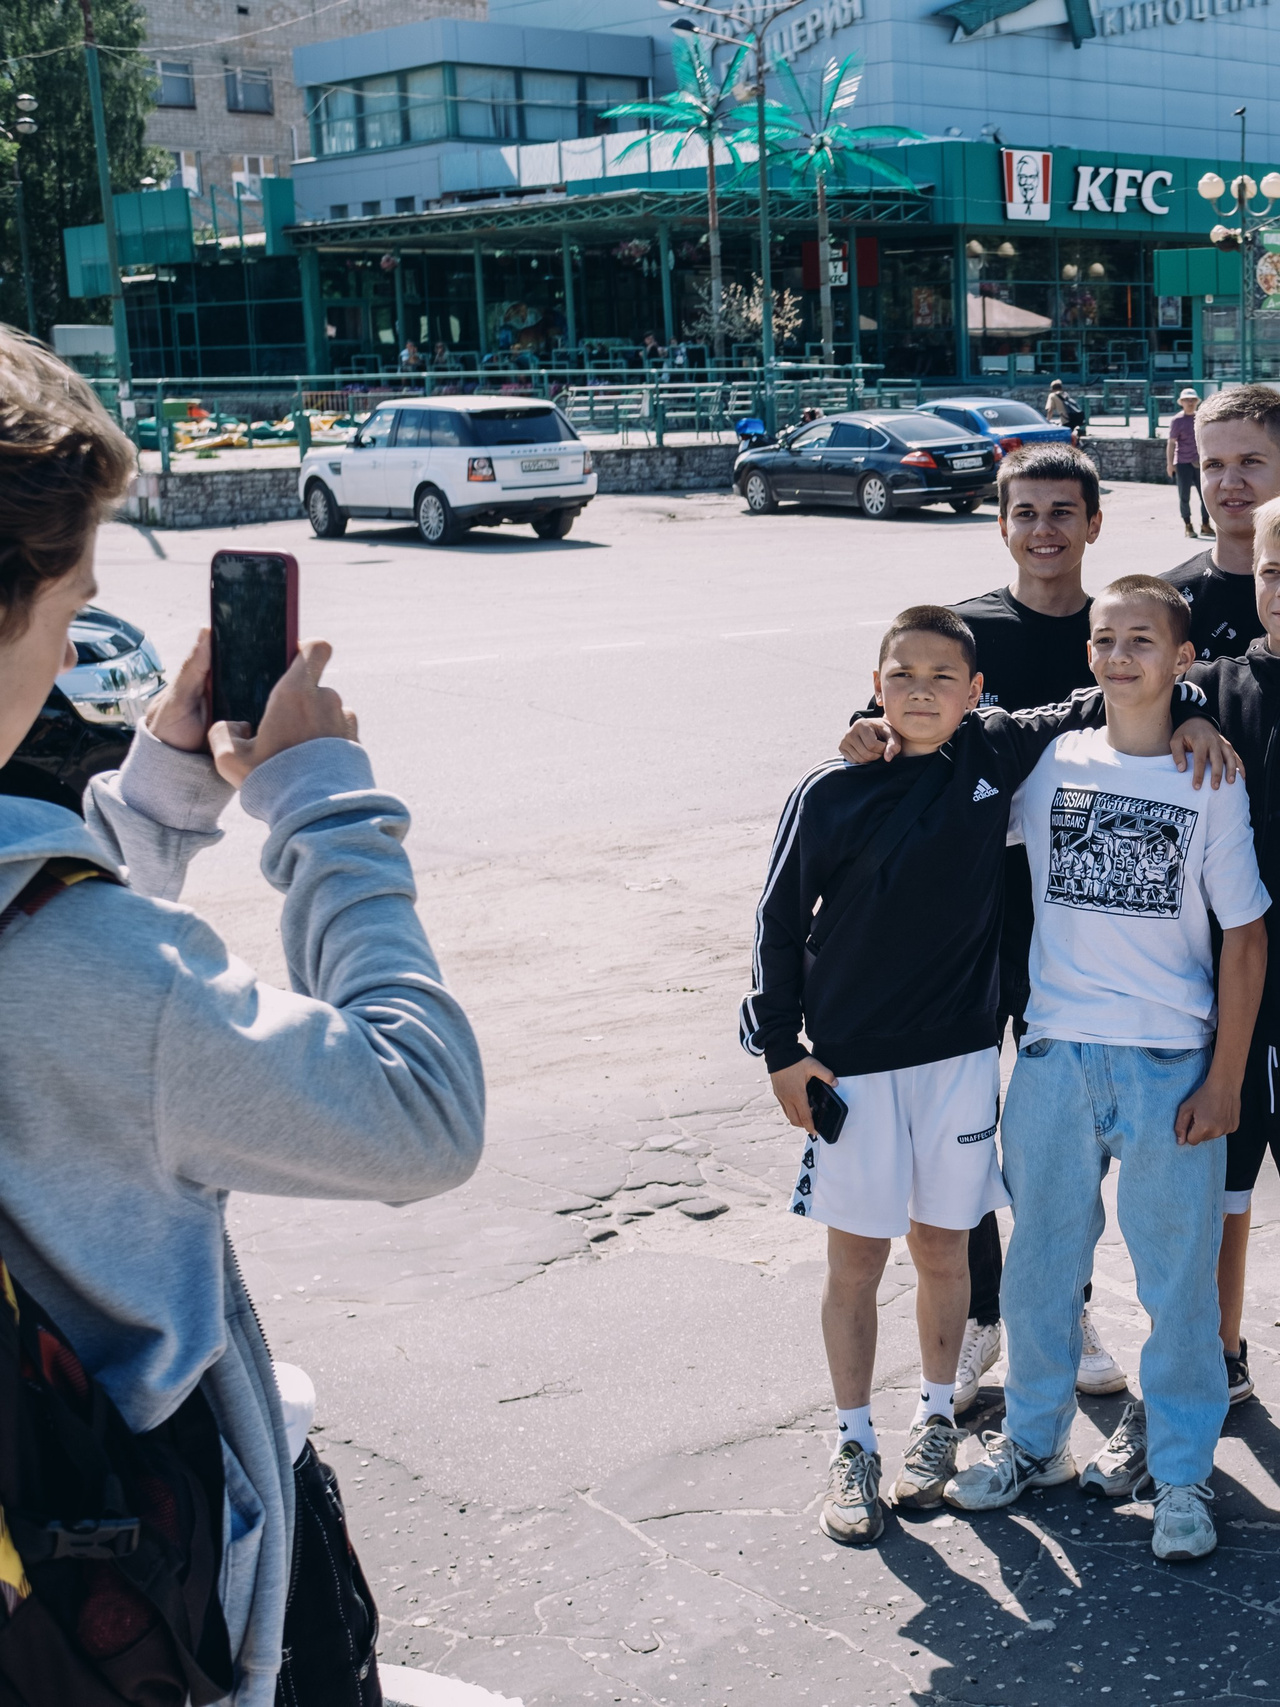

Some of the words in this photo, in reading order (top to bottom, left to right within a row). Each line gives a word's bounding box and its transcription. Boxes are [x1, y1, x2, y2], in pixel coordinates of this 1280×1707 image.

[1102, 0, 1269, 37] КИНОЦЕ
[1072, 165, 1174, 215] KFC
[972, 787, 1000, 802] adidas
[1053, 791, 1094, 810] RUSSIAN
[1051, 814, 1086, 829] HOOLIGANS
